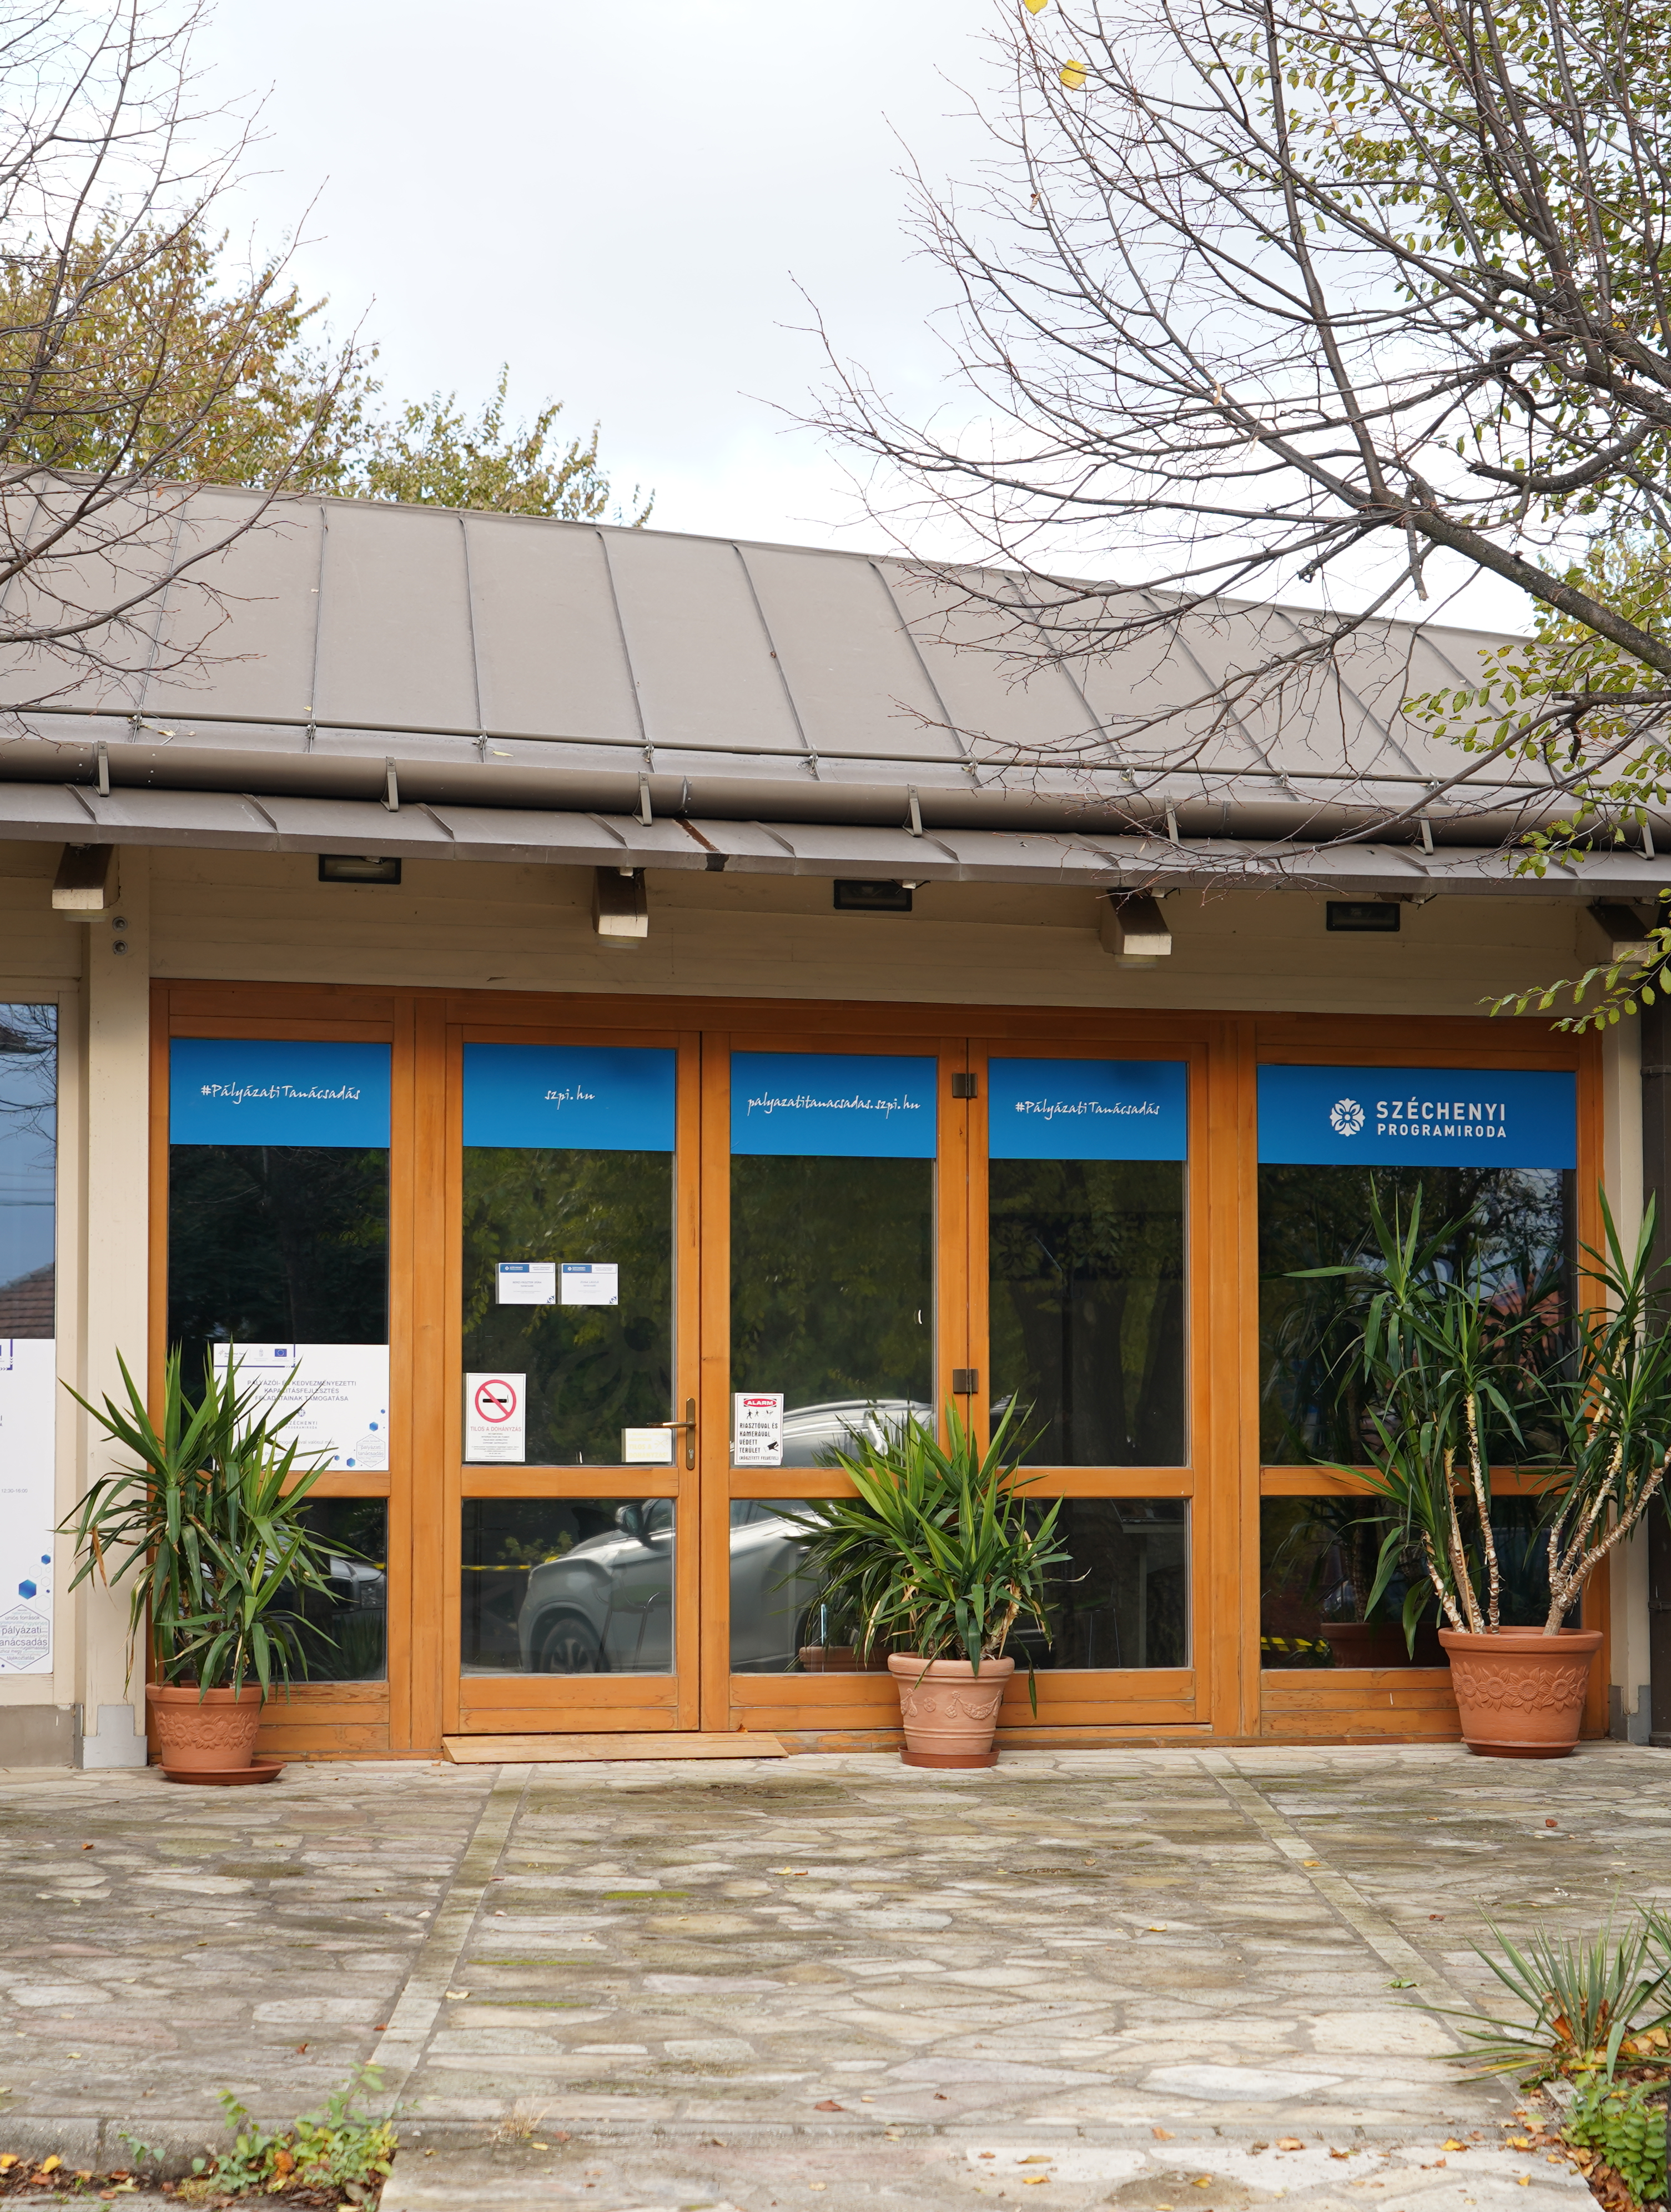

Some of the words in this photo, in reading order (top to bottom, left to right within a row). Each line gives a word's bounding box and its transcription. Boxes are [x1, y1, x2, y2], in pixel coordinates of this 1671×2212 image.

[544, 1085, 595, 1110] szpi.hu
[747, 1091, 920, 1119] palyazatitanacsadas.szpi.hu
[1376, 1096, 1505, 1121] SZÉCHENYI
[1377, 1123, 1507, 1138] PROGRAMIRODA
[2, 1625, 42, 1636] pályázati
[0, 1637, 48, 1646] anácsadás
